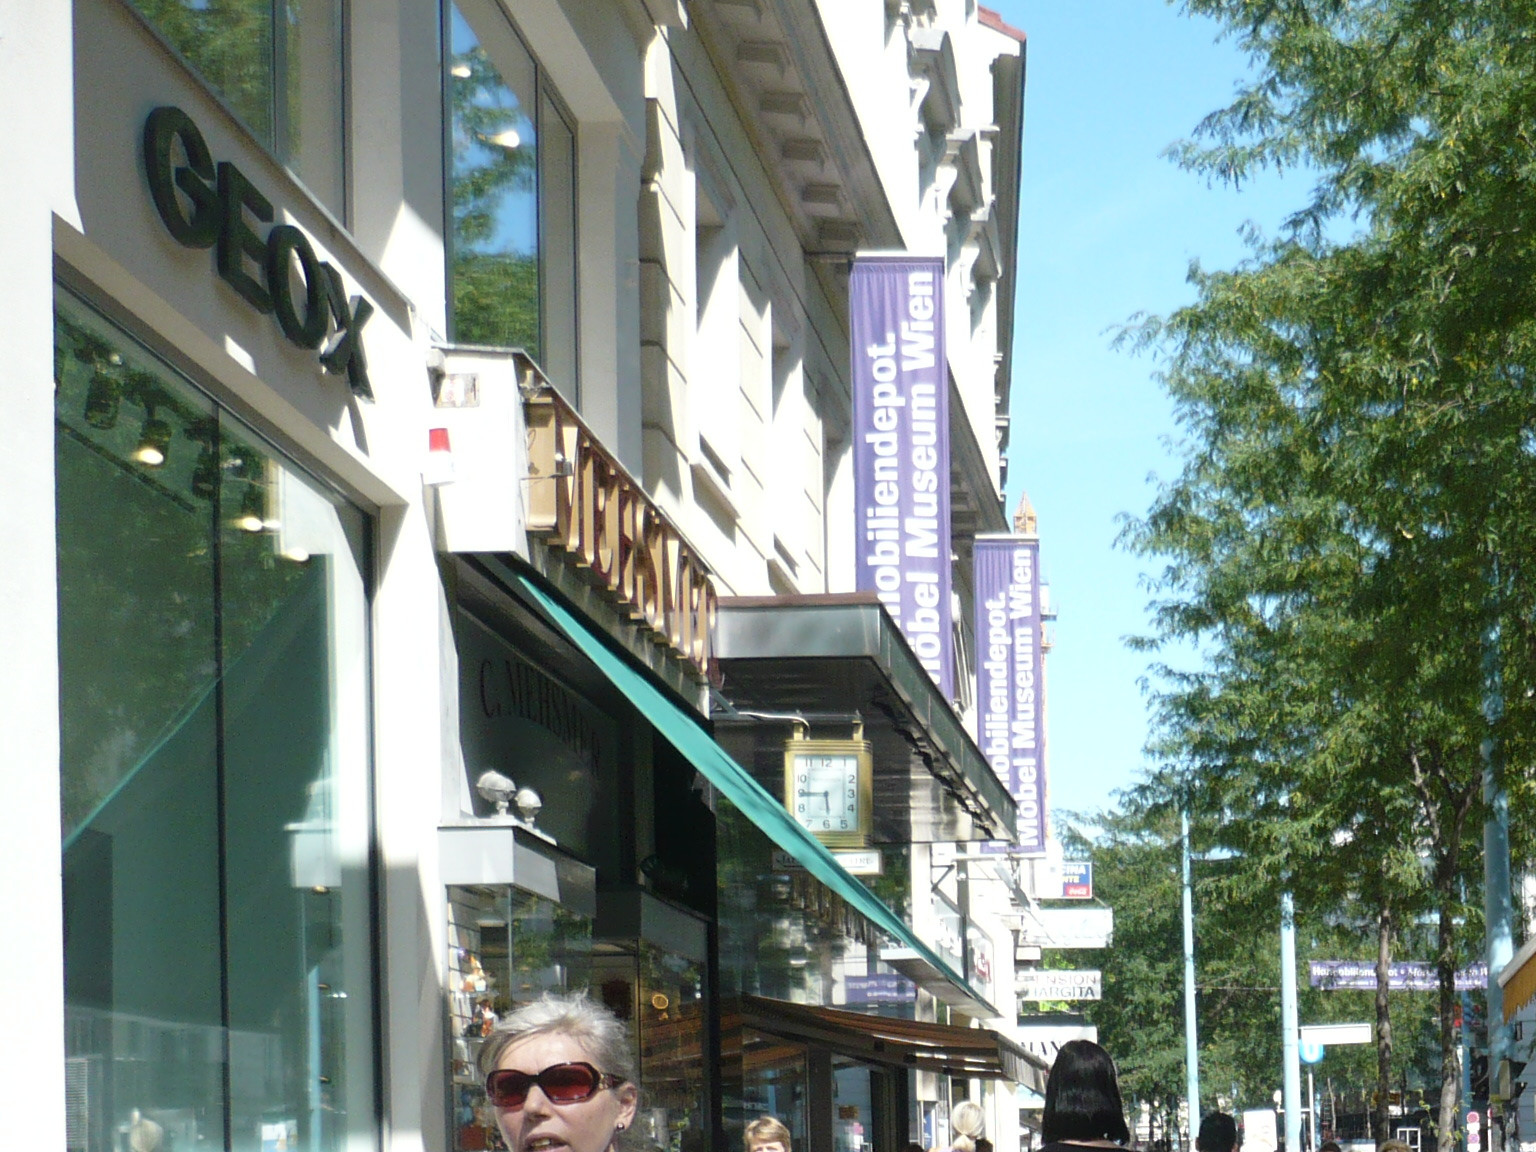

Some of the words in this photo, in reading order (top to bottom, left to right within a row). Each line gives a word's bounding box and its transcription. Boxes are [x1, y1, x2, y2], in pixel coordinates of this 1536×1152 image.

[144, 106, 375, 402] GEOX
[901, 272, 935, 372] Wien
[905, 384, 938, 558] Museum
[1009, 549, 1032, 620] Wien
[1012, 627, 1035, 749] Museum
[821, 757, 832, 767] 12
[797, 774, 807, 784] 10
[848, 774, 855, 784] 2
[847, 789, 855, 798] 3
[798, 804, 805, 813] 8
[847, 803, 855, 813] 4
[805, 819, 813, 828] 7
[822, 819, 831, 829] 6
[840, 819, 848, 829] 5
